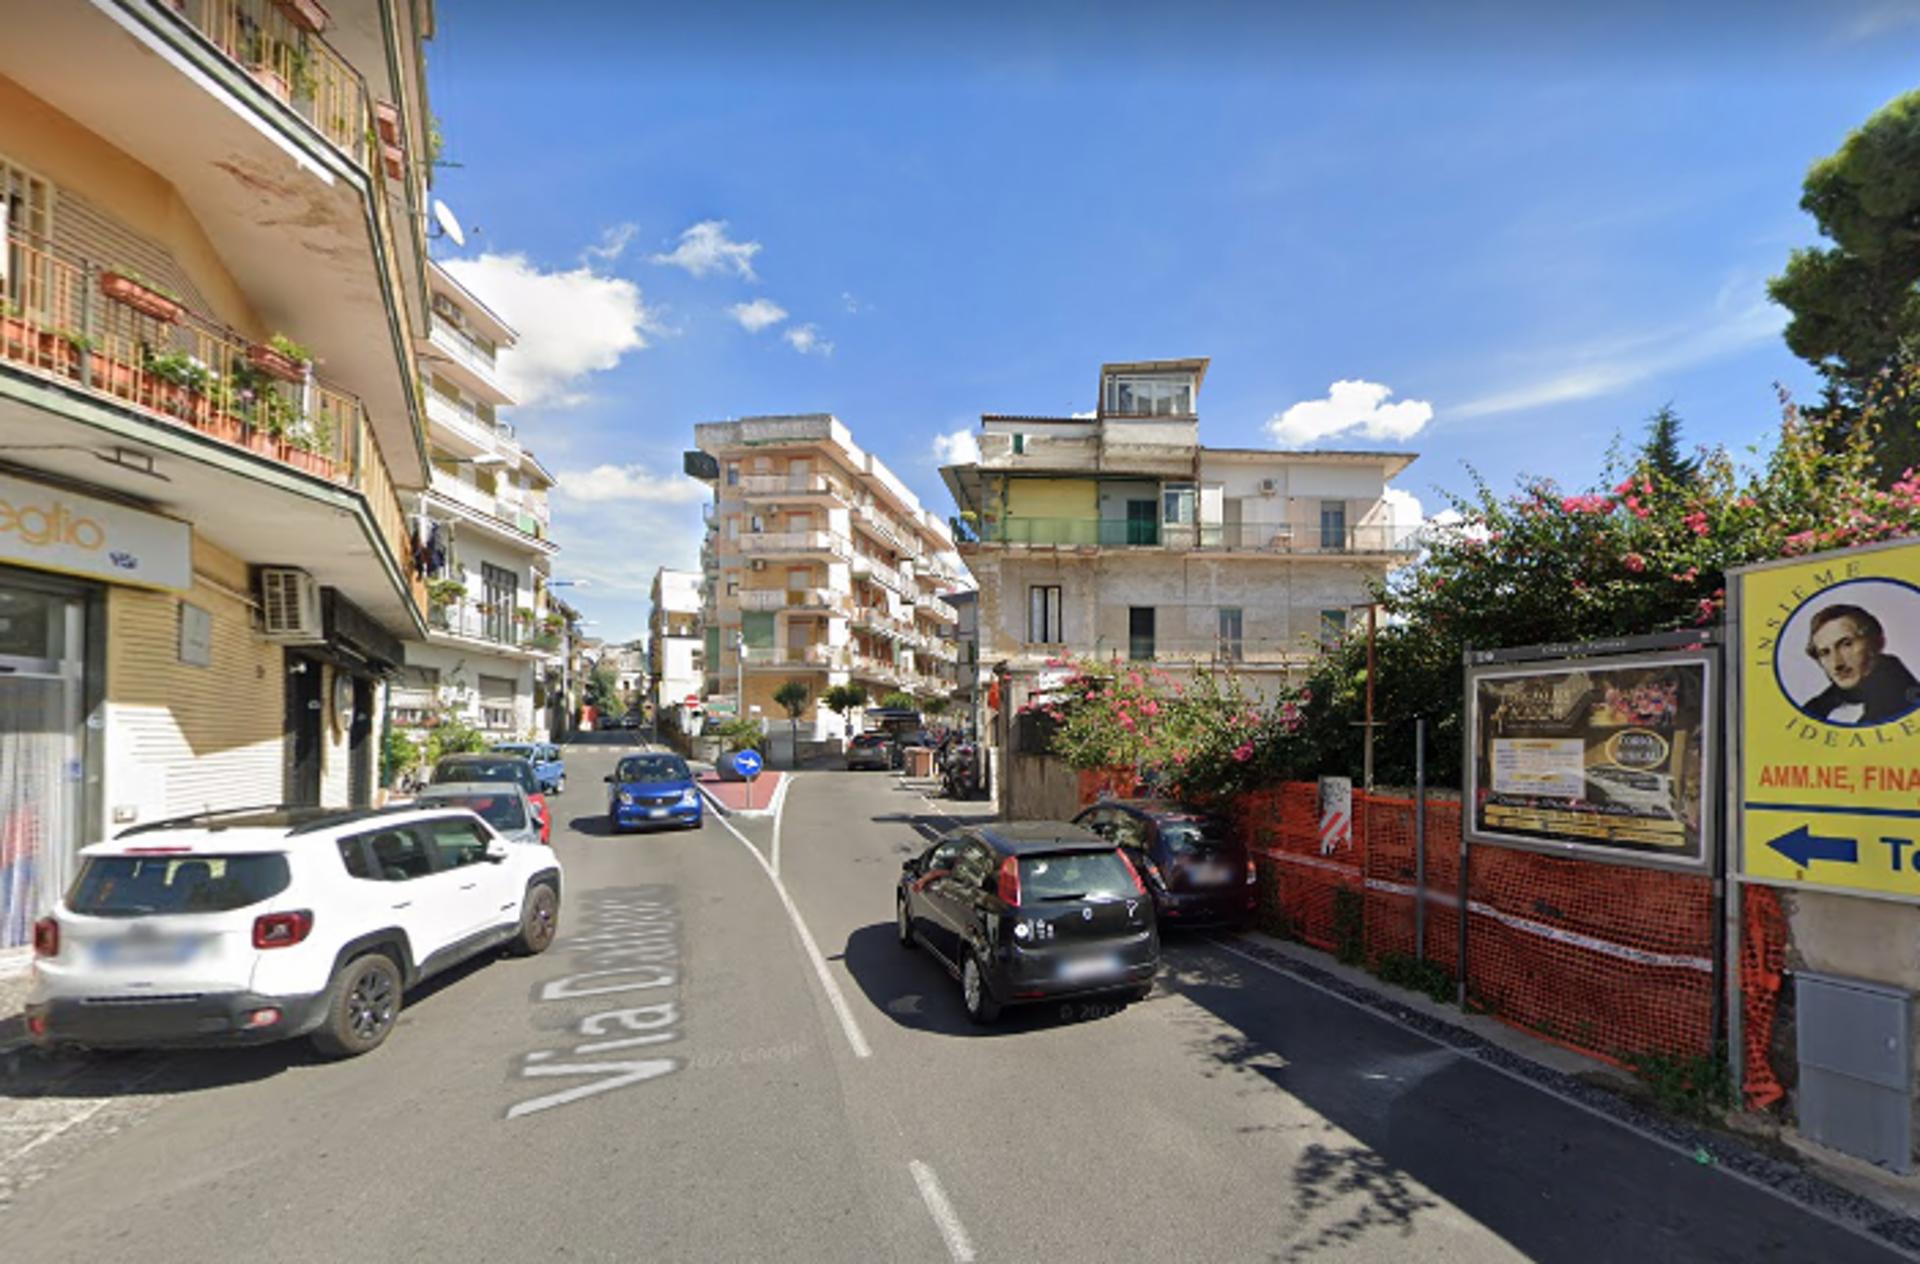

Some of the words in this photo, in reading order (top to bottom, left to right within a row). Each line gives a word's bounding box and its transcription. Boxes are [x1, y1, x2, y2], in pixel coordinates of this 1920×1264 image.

[1757, 561, 1861, 668] INSIEME
[1785, 717, 1920, 748] IDEALE
[1759, 765, 1856, 794] AMM.NE,
[1864, 766, 1920, 792] FINA
